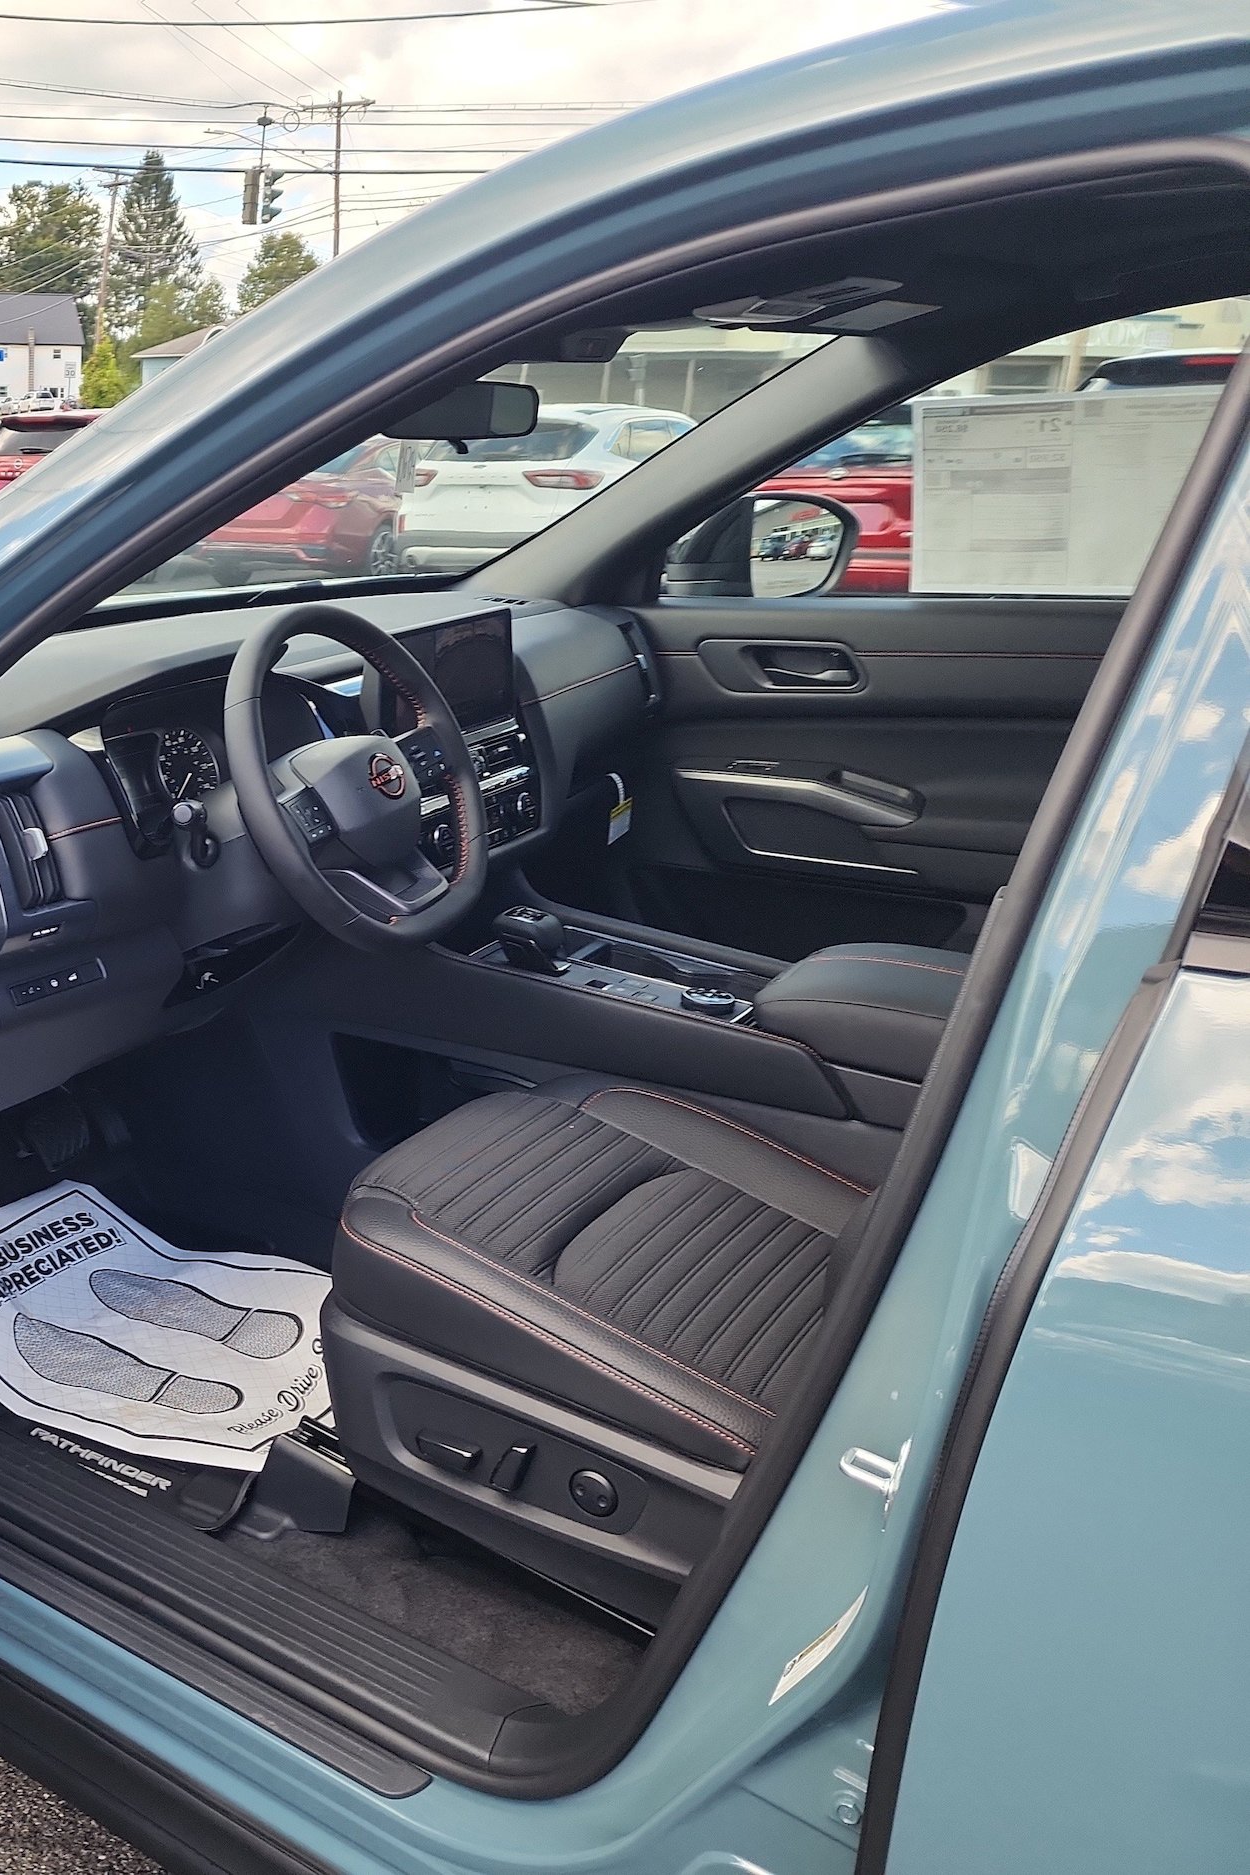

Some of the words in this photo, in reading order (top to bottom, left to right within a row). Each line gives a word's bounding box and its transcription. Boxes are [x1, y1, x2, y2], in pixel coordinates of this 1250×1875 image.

[65, 369, 76, 377] 30
[227, 1408, 281, 1434] Please
[276, 1366, 320, 1413] Drive
[29, 1427, 173, 1491] PATHFINDER
